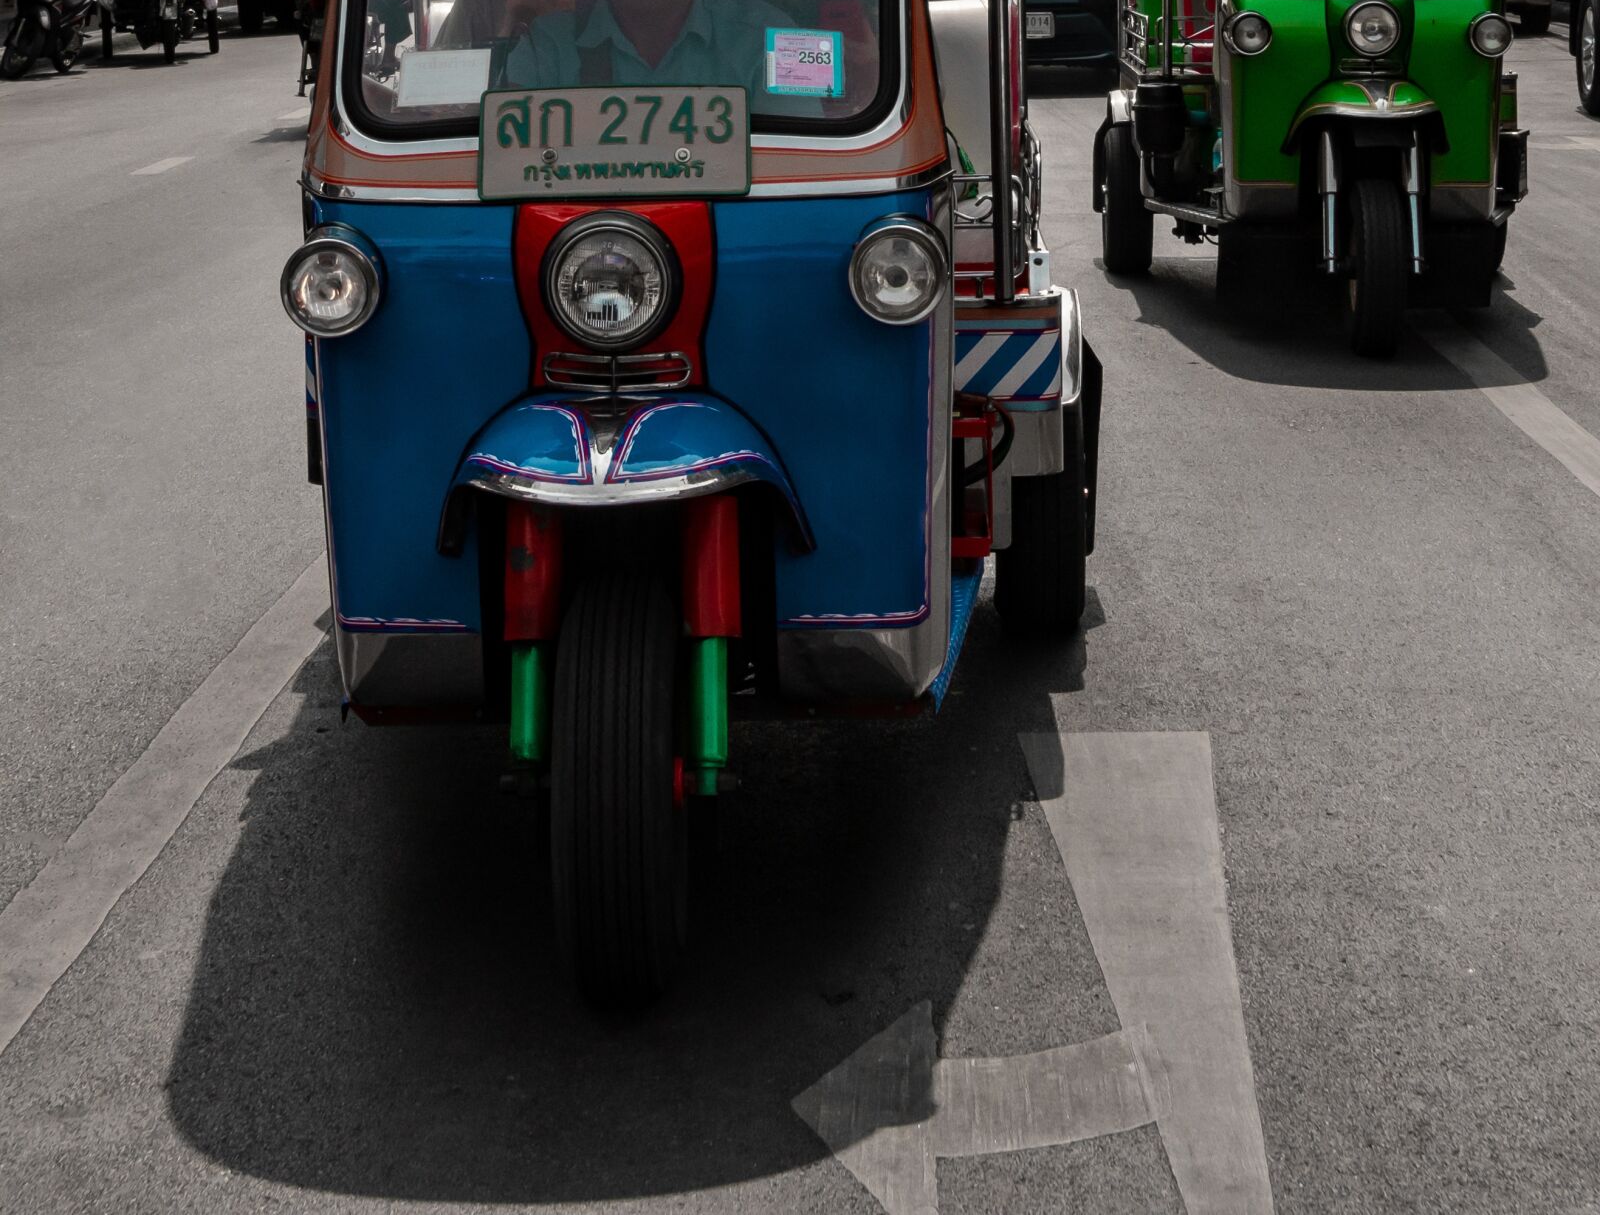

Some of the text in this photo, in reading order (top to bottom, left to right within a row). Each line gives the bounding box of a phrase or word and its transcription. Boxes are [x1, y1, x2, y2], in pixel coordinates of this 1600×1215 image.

[798, 51, 831, 65] 2563
[496, 95, 734, 149] สก 2743
[524, 159, 705, 188] กรุงเทพมหานคร
